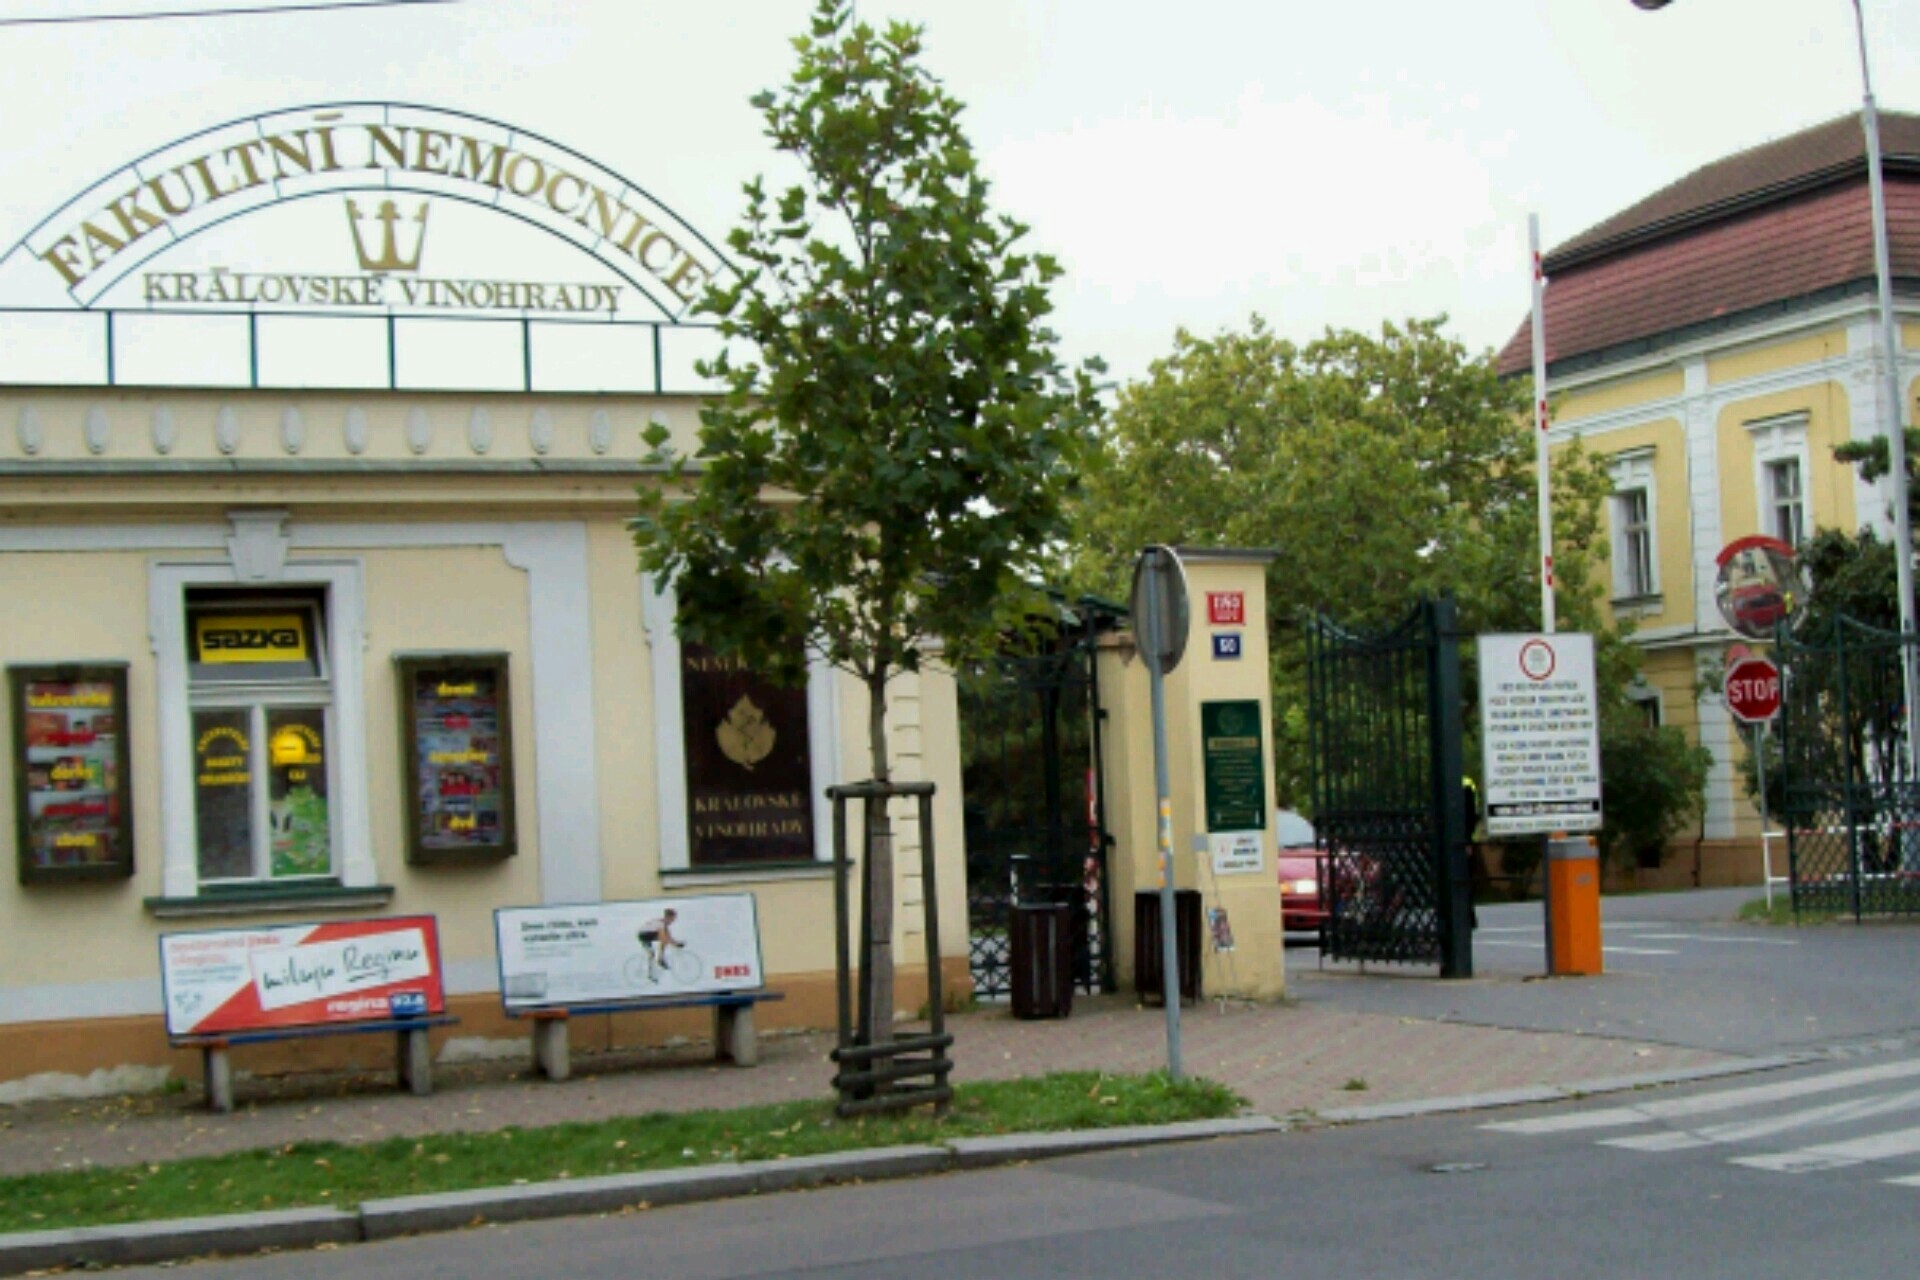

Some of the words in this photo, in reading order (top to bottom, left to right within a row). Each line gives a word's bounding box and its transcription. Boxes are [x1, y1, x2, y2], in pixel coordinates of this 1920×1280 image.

[40, 112, 343, 287] FAKULTNÍ
[364, 124, 713, 306] NEMOCNICE
[400, 279, 624, 312] VINOHRADY
[1728, 678, 1780, 703] STOP
